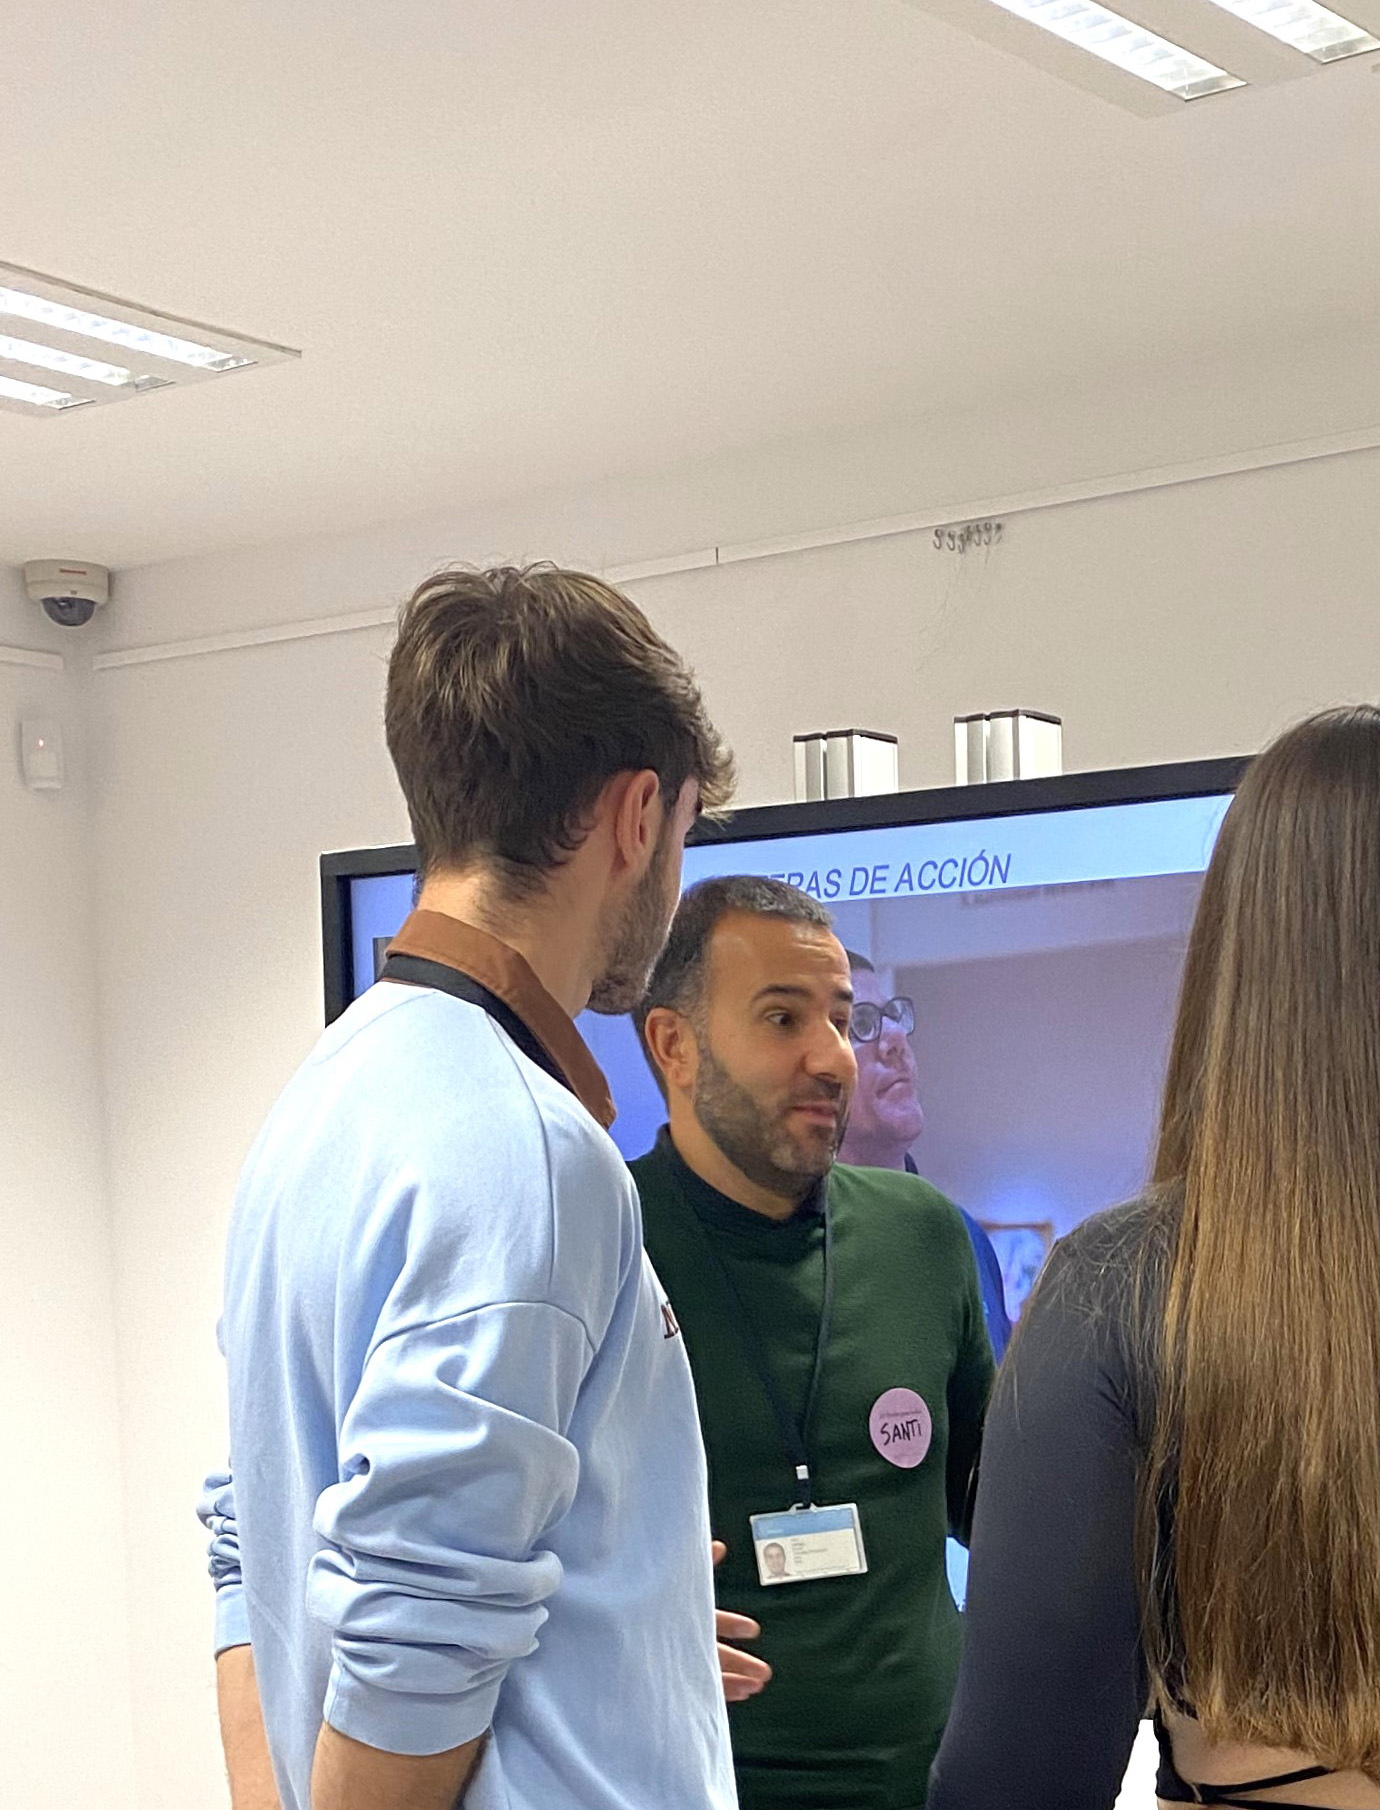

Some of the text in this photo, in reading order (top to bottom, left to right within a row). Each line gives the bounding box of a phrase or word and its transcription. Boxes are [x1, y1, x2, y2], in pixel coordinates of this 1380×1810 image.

[849, 864, 890, 896] DE
[894, 849, 1012, 893] ACCIÓN
[880, 1418, 922, 1446] SANTI
